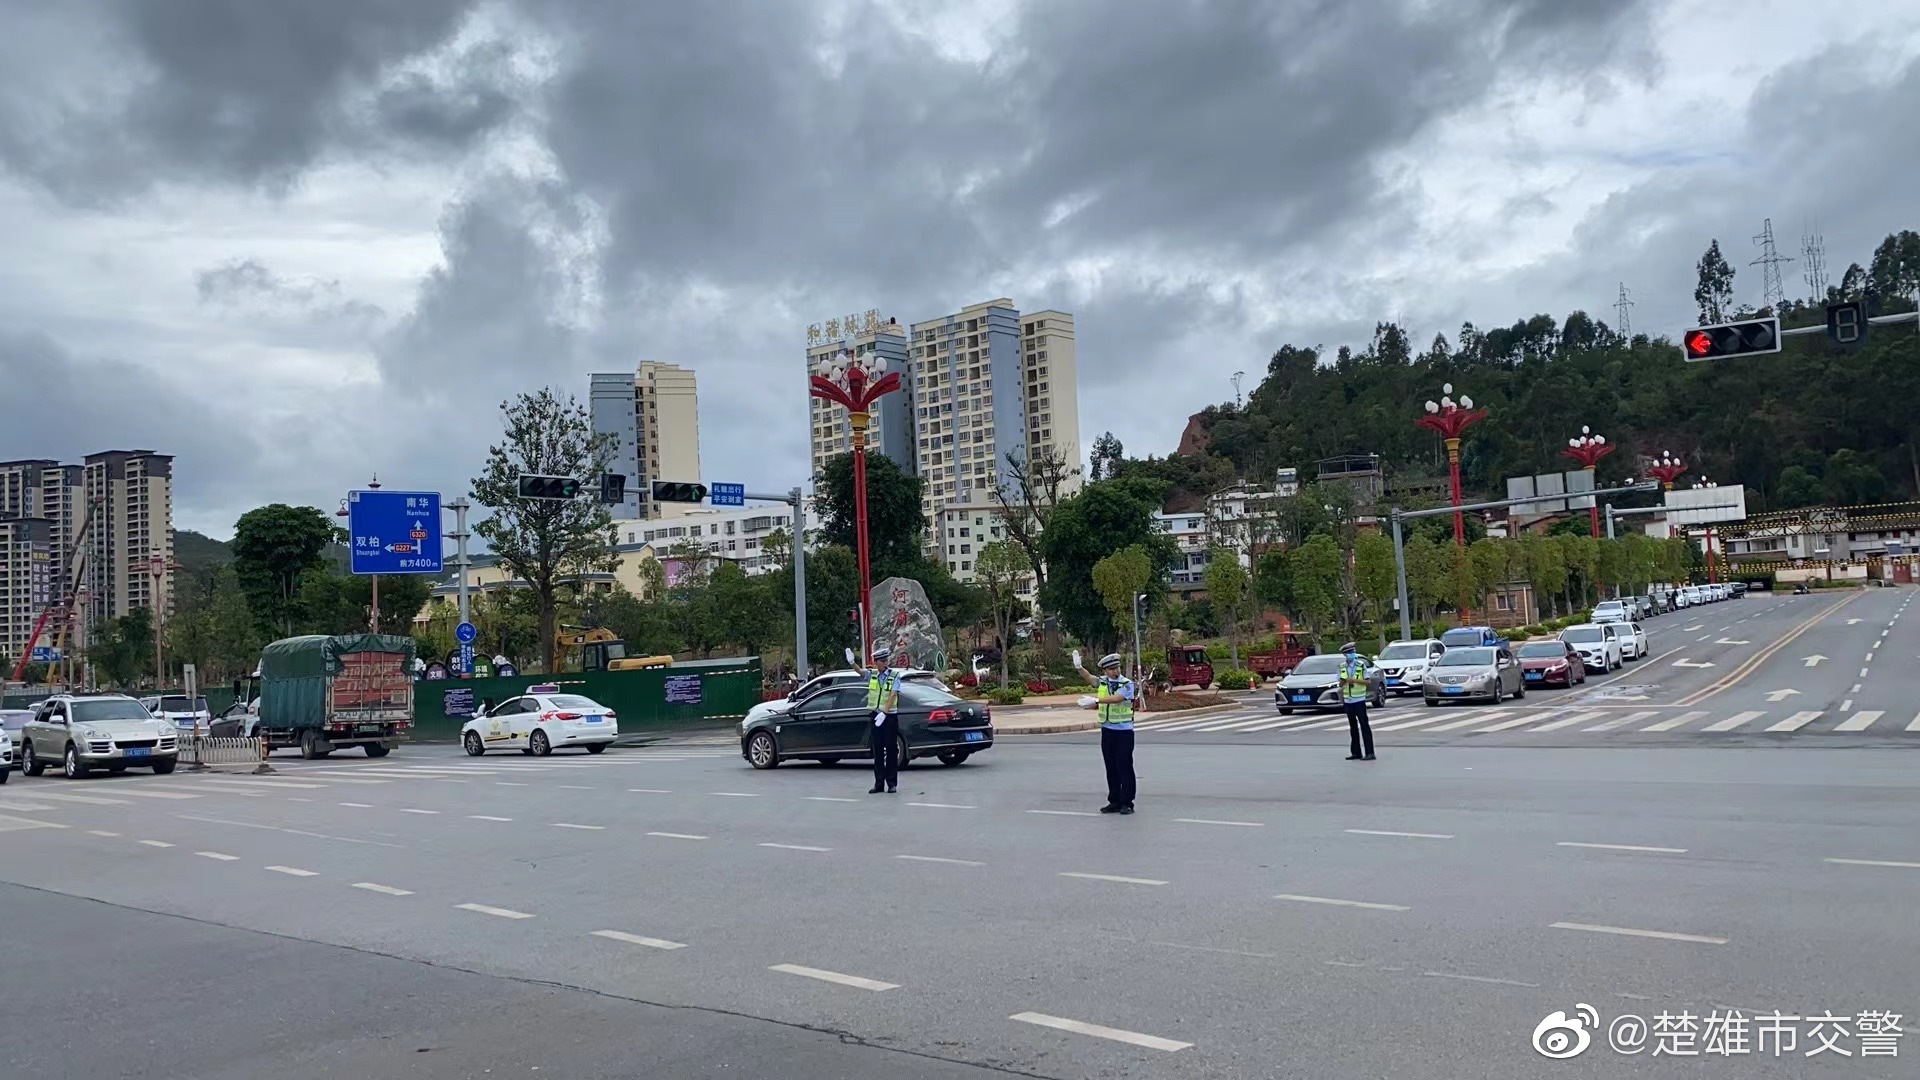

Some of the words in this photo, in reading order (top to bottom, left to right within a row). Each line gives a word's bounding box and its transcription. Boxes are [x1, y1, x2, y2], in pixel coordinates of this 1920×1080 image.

[406, 497, 428, 508] 南华
[713, 494, 742, 503] 平安到家
[356, 536, 380, 547] 双柏
